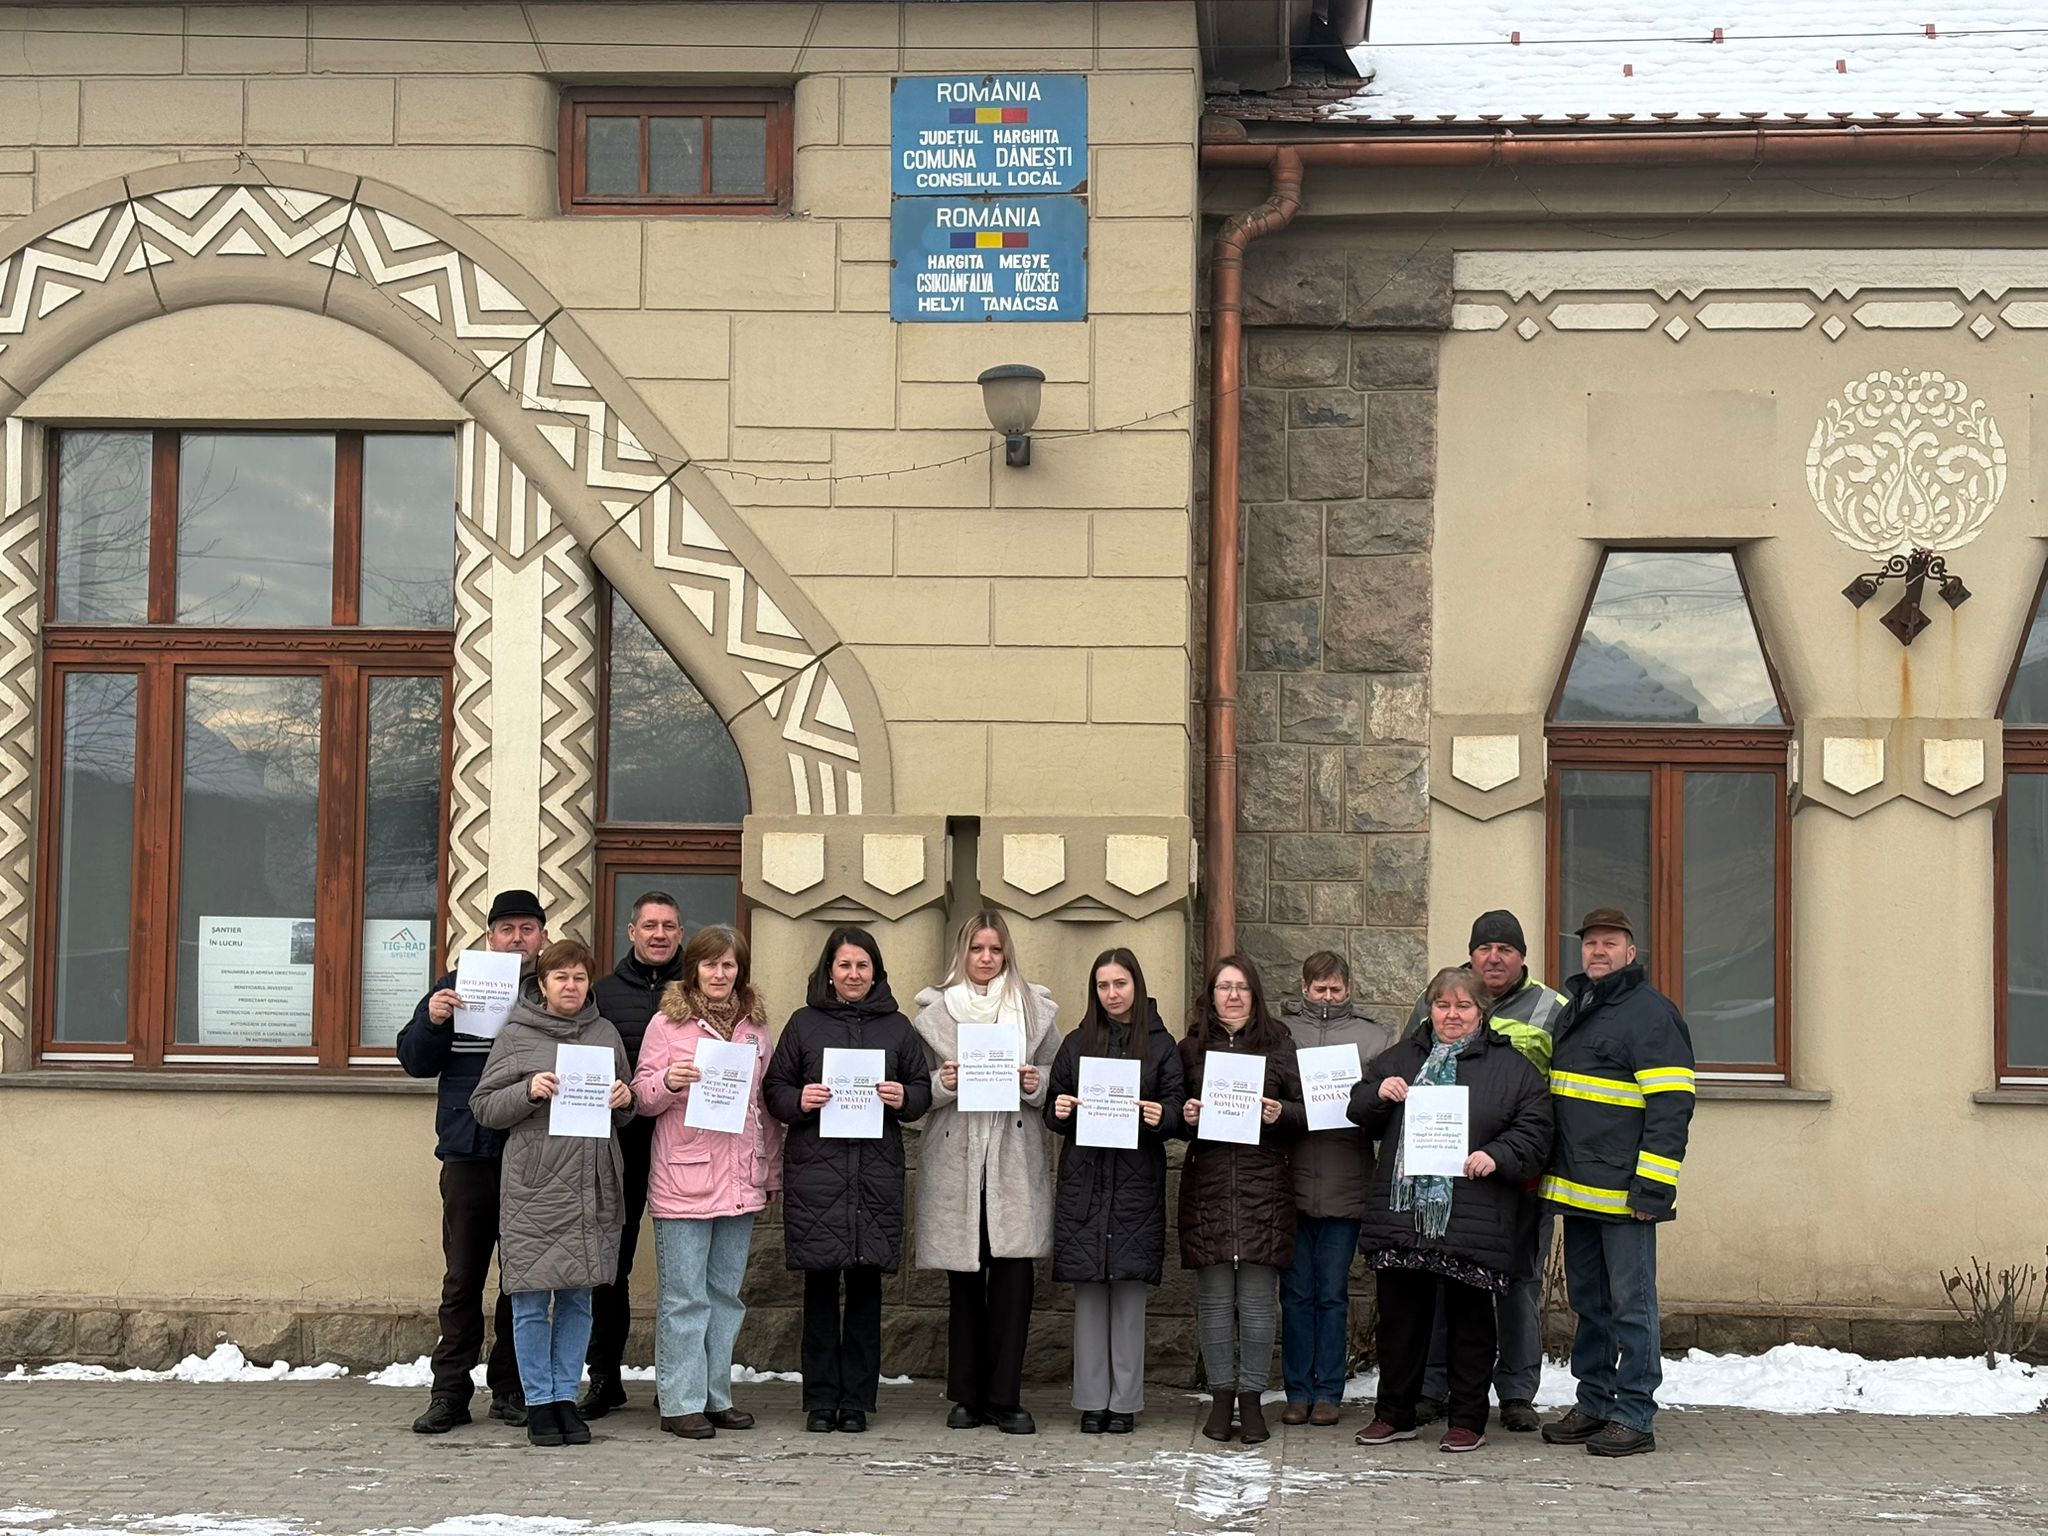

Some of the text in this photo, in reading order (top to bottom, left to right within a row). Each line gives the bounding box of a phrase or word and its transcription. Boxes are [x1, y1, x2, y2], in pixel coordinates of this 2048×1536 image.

[994, 129, 1059, 144] HARGHITA
[903, 149, 977, 169] COMUNA
[916, 171, 1062, 188] CONSILIUL LOCAL
[936, 203, 1041, 227] ROMÁNIA
[928, 254, 1050, 269] HARGITA MEGYE
[918, 293, 1059, 312] HELYI TANÁCSA
[382, 941, 426, 951] TIG-RAD
[1311, 1089, 1350, 1103] ROMÂN
